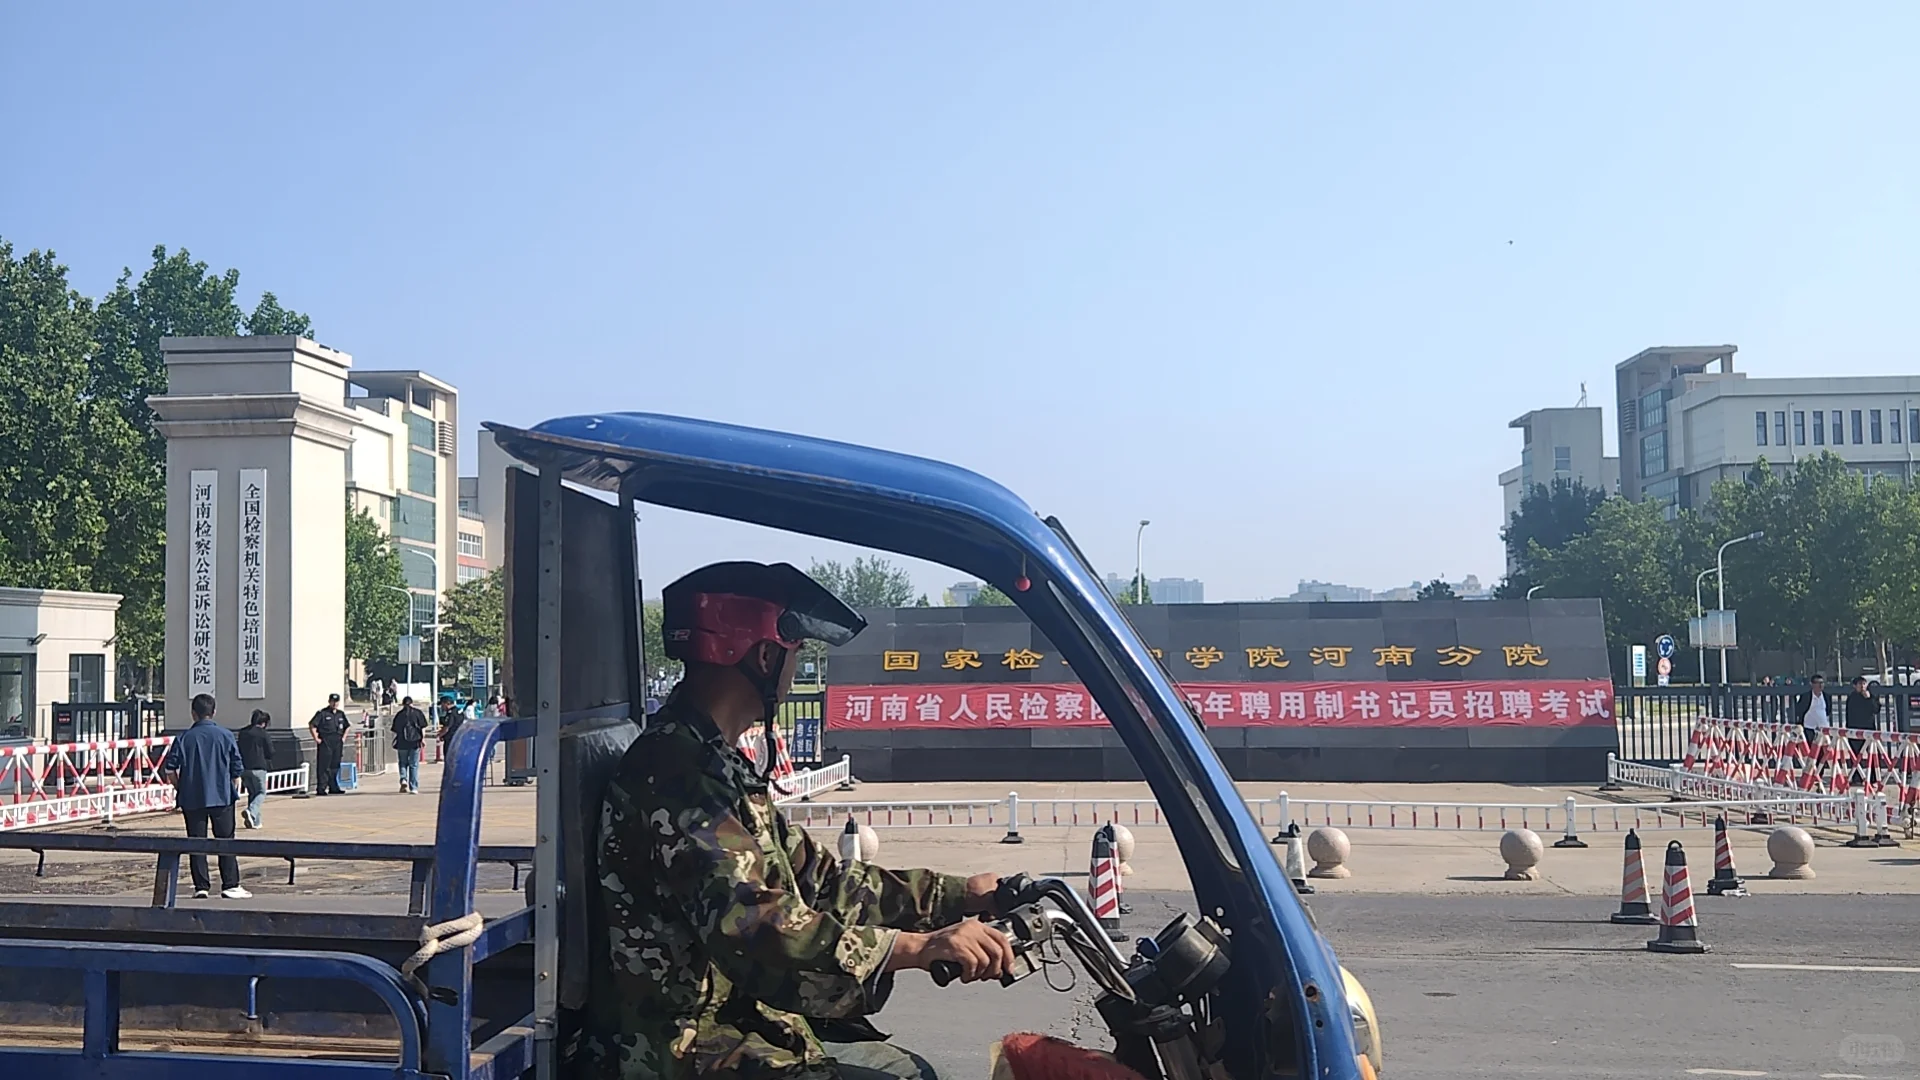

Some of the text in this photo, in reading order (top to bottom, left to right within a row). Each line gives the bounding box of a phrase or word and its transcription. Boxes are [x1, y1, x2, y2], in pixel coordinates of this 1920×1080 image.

[192, 484, 212, 684] 河南检察公益诉讼研究院
[242, 483, 262, 685] 全国检察机关特色培训基地
[882, 645, 1549, 671] 国家检学院河南分院
